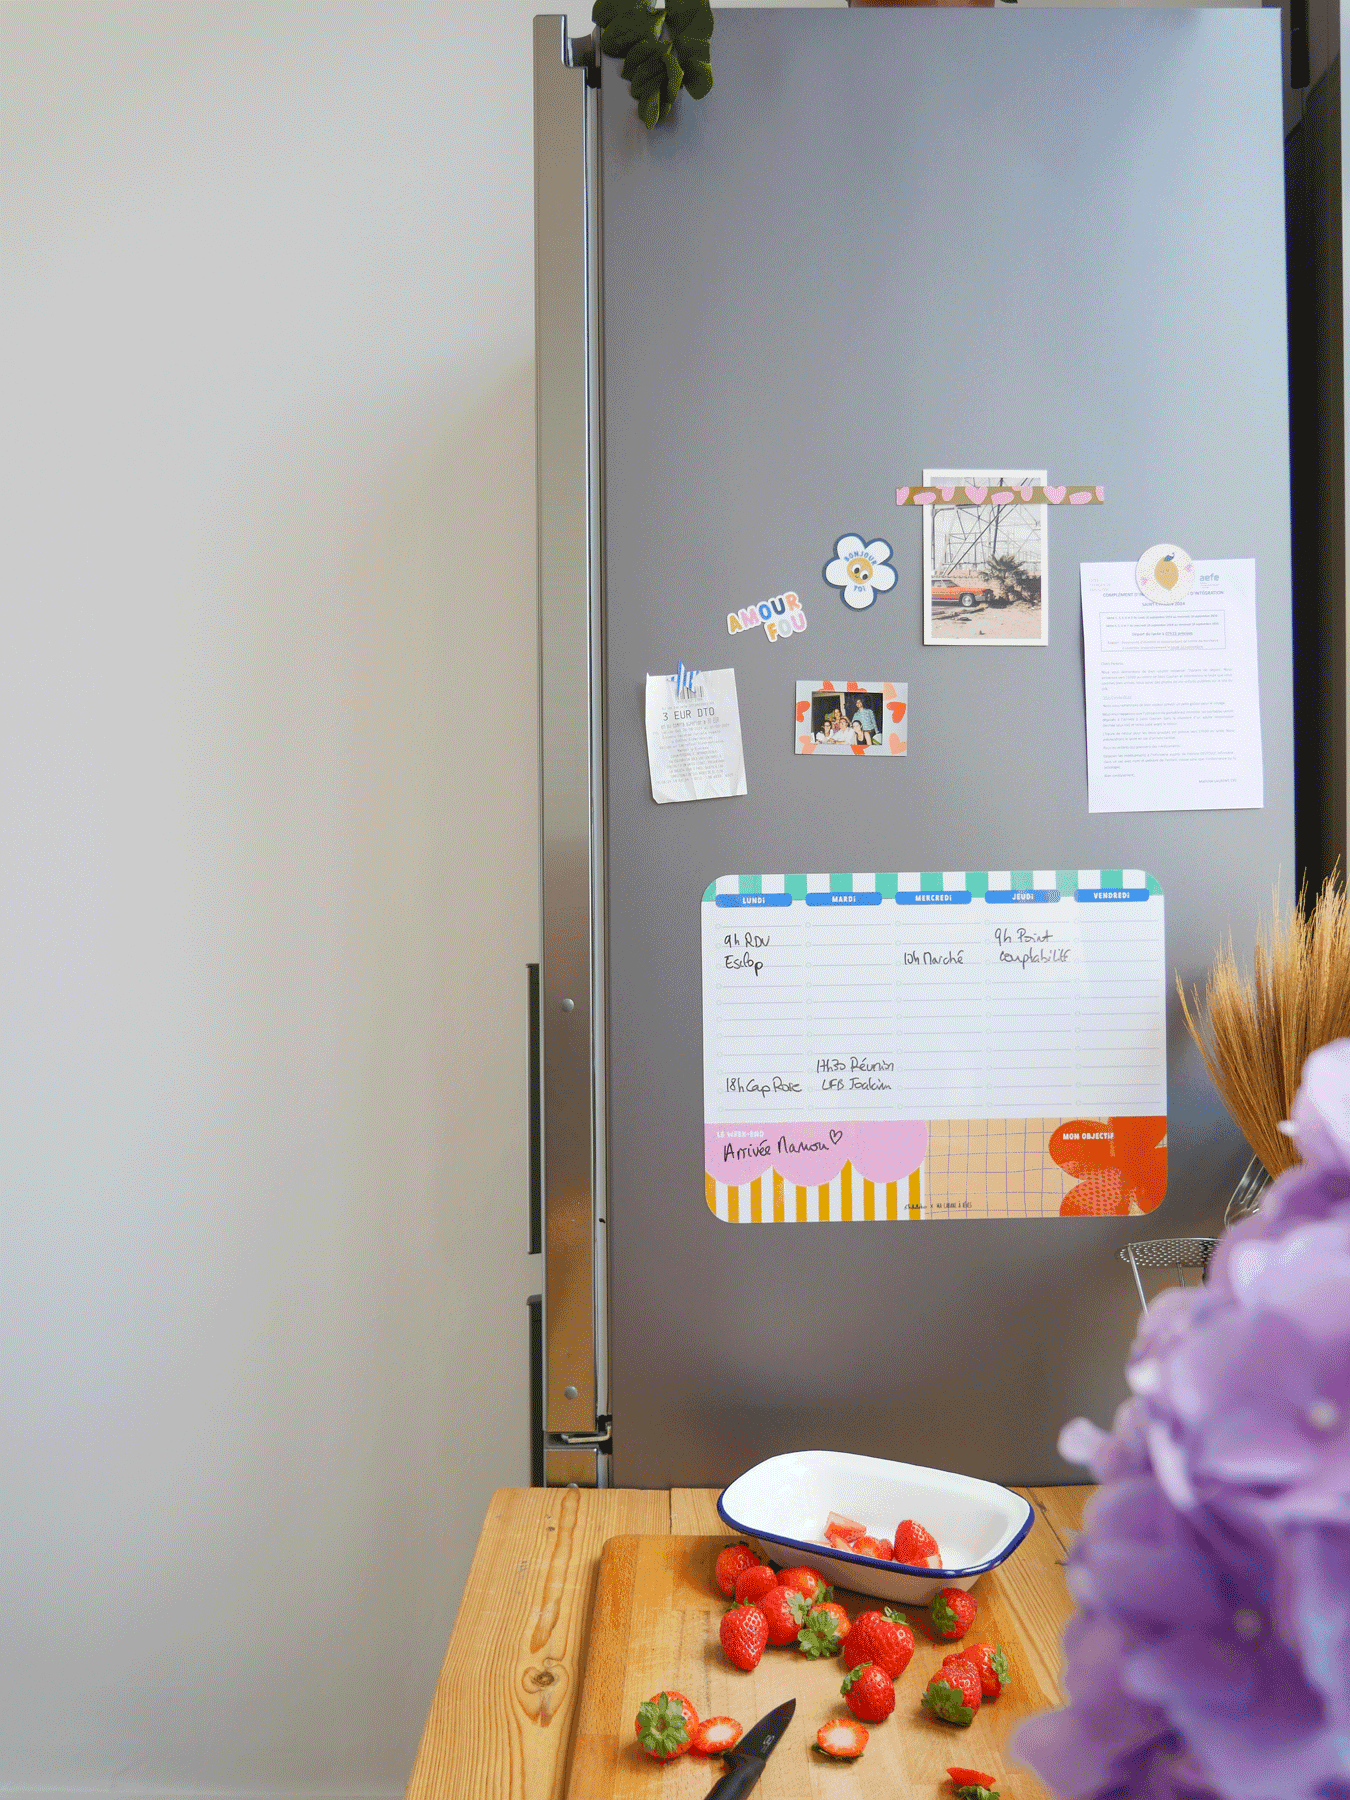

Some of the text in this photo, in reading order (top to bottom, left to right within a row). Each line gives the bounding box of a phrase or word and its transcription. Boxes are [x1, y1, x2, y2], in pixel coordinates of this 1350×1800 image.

[844, 551, 877, 566] BONJOUR
[1199, 573, 1219, 582] aefe
[729, 593, 800, 633] AMOUR
[767, 612, 806, 641] FOU
[662, 712, 669, 721] 3
[674, 710, 692, 720] EUR
[697, 706, 715, 718] DTO
[745, 931, 771, 948] RDV
[994, 927, 1054, 947] 9h Point
[850, 1056, 895, 1073] Réunion
[726, 1077, 744, 1093] 18h
[746, 1078, 771, 1098] Cap
[1062, 1132, 1080, 1140] MON
[723, 1139, 771, 1163] Arrivée
